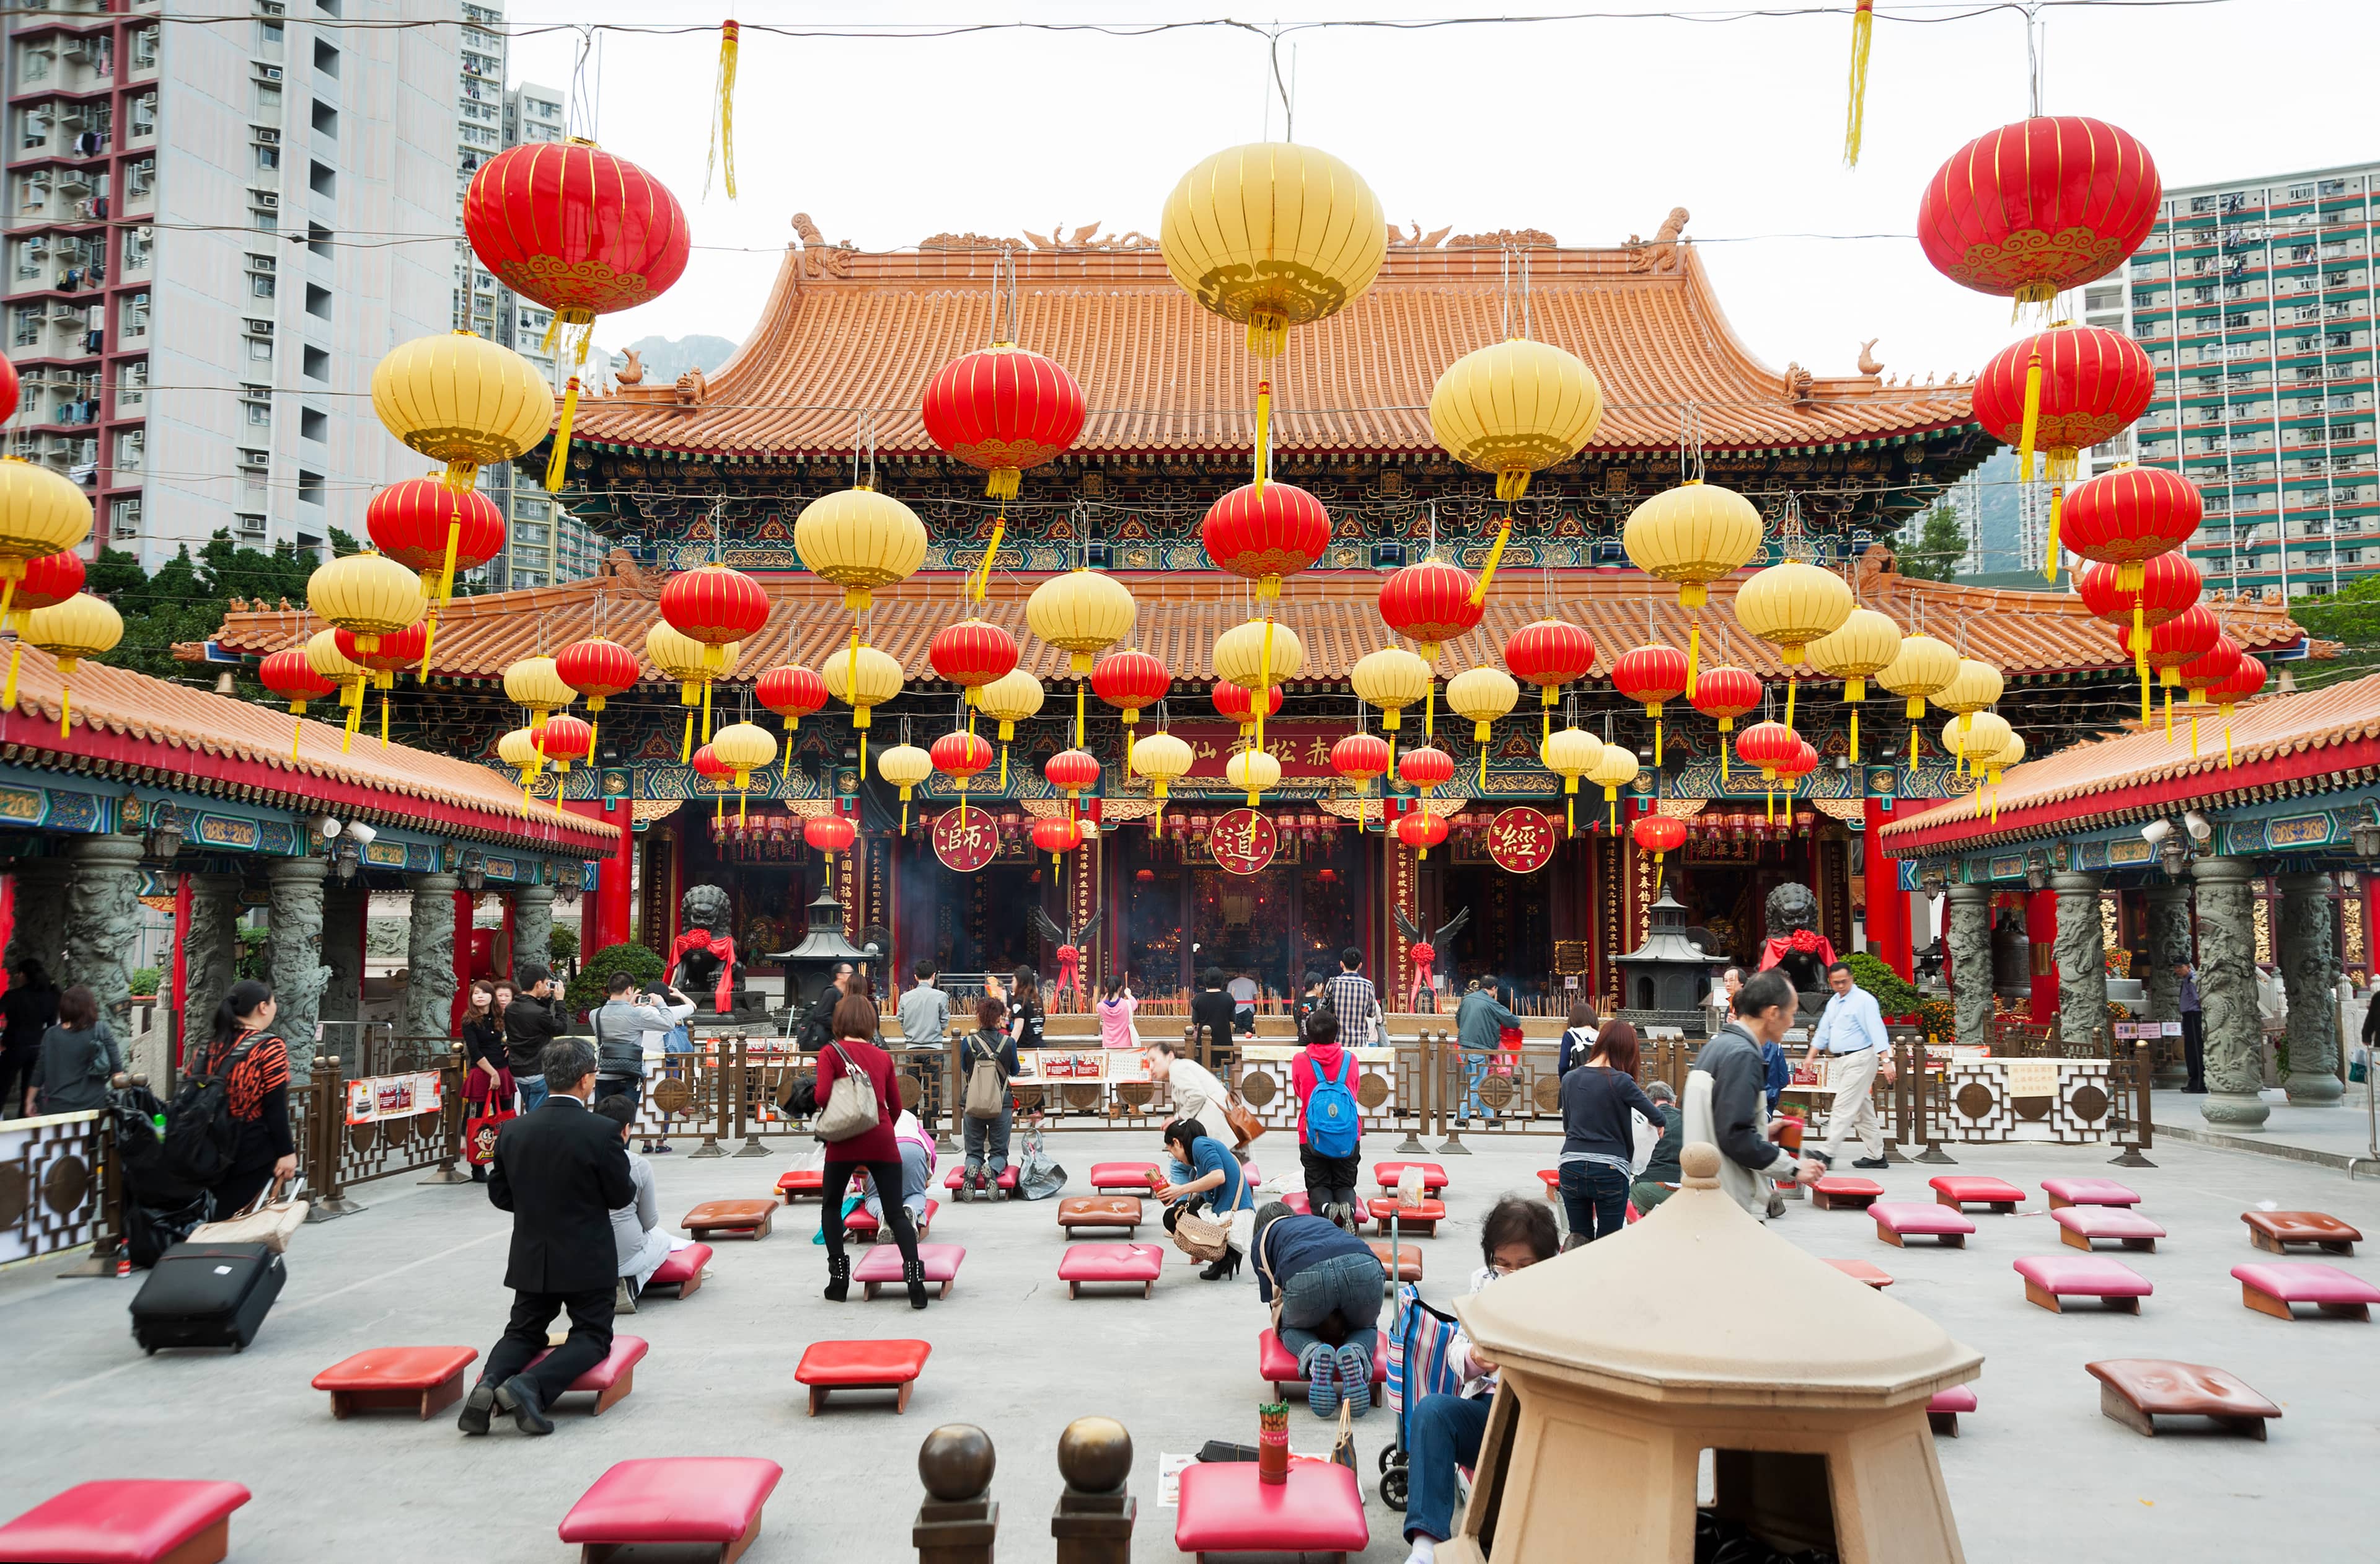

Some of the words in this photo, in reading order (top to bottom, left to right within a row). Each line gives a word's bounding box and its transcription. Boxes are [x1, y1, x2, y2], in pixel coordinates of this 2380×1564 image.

[948, 820, 982, 857] 師
[1223, 821, 1262, 862] 道
[1501, 823, 1537, 857] 經
